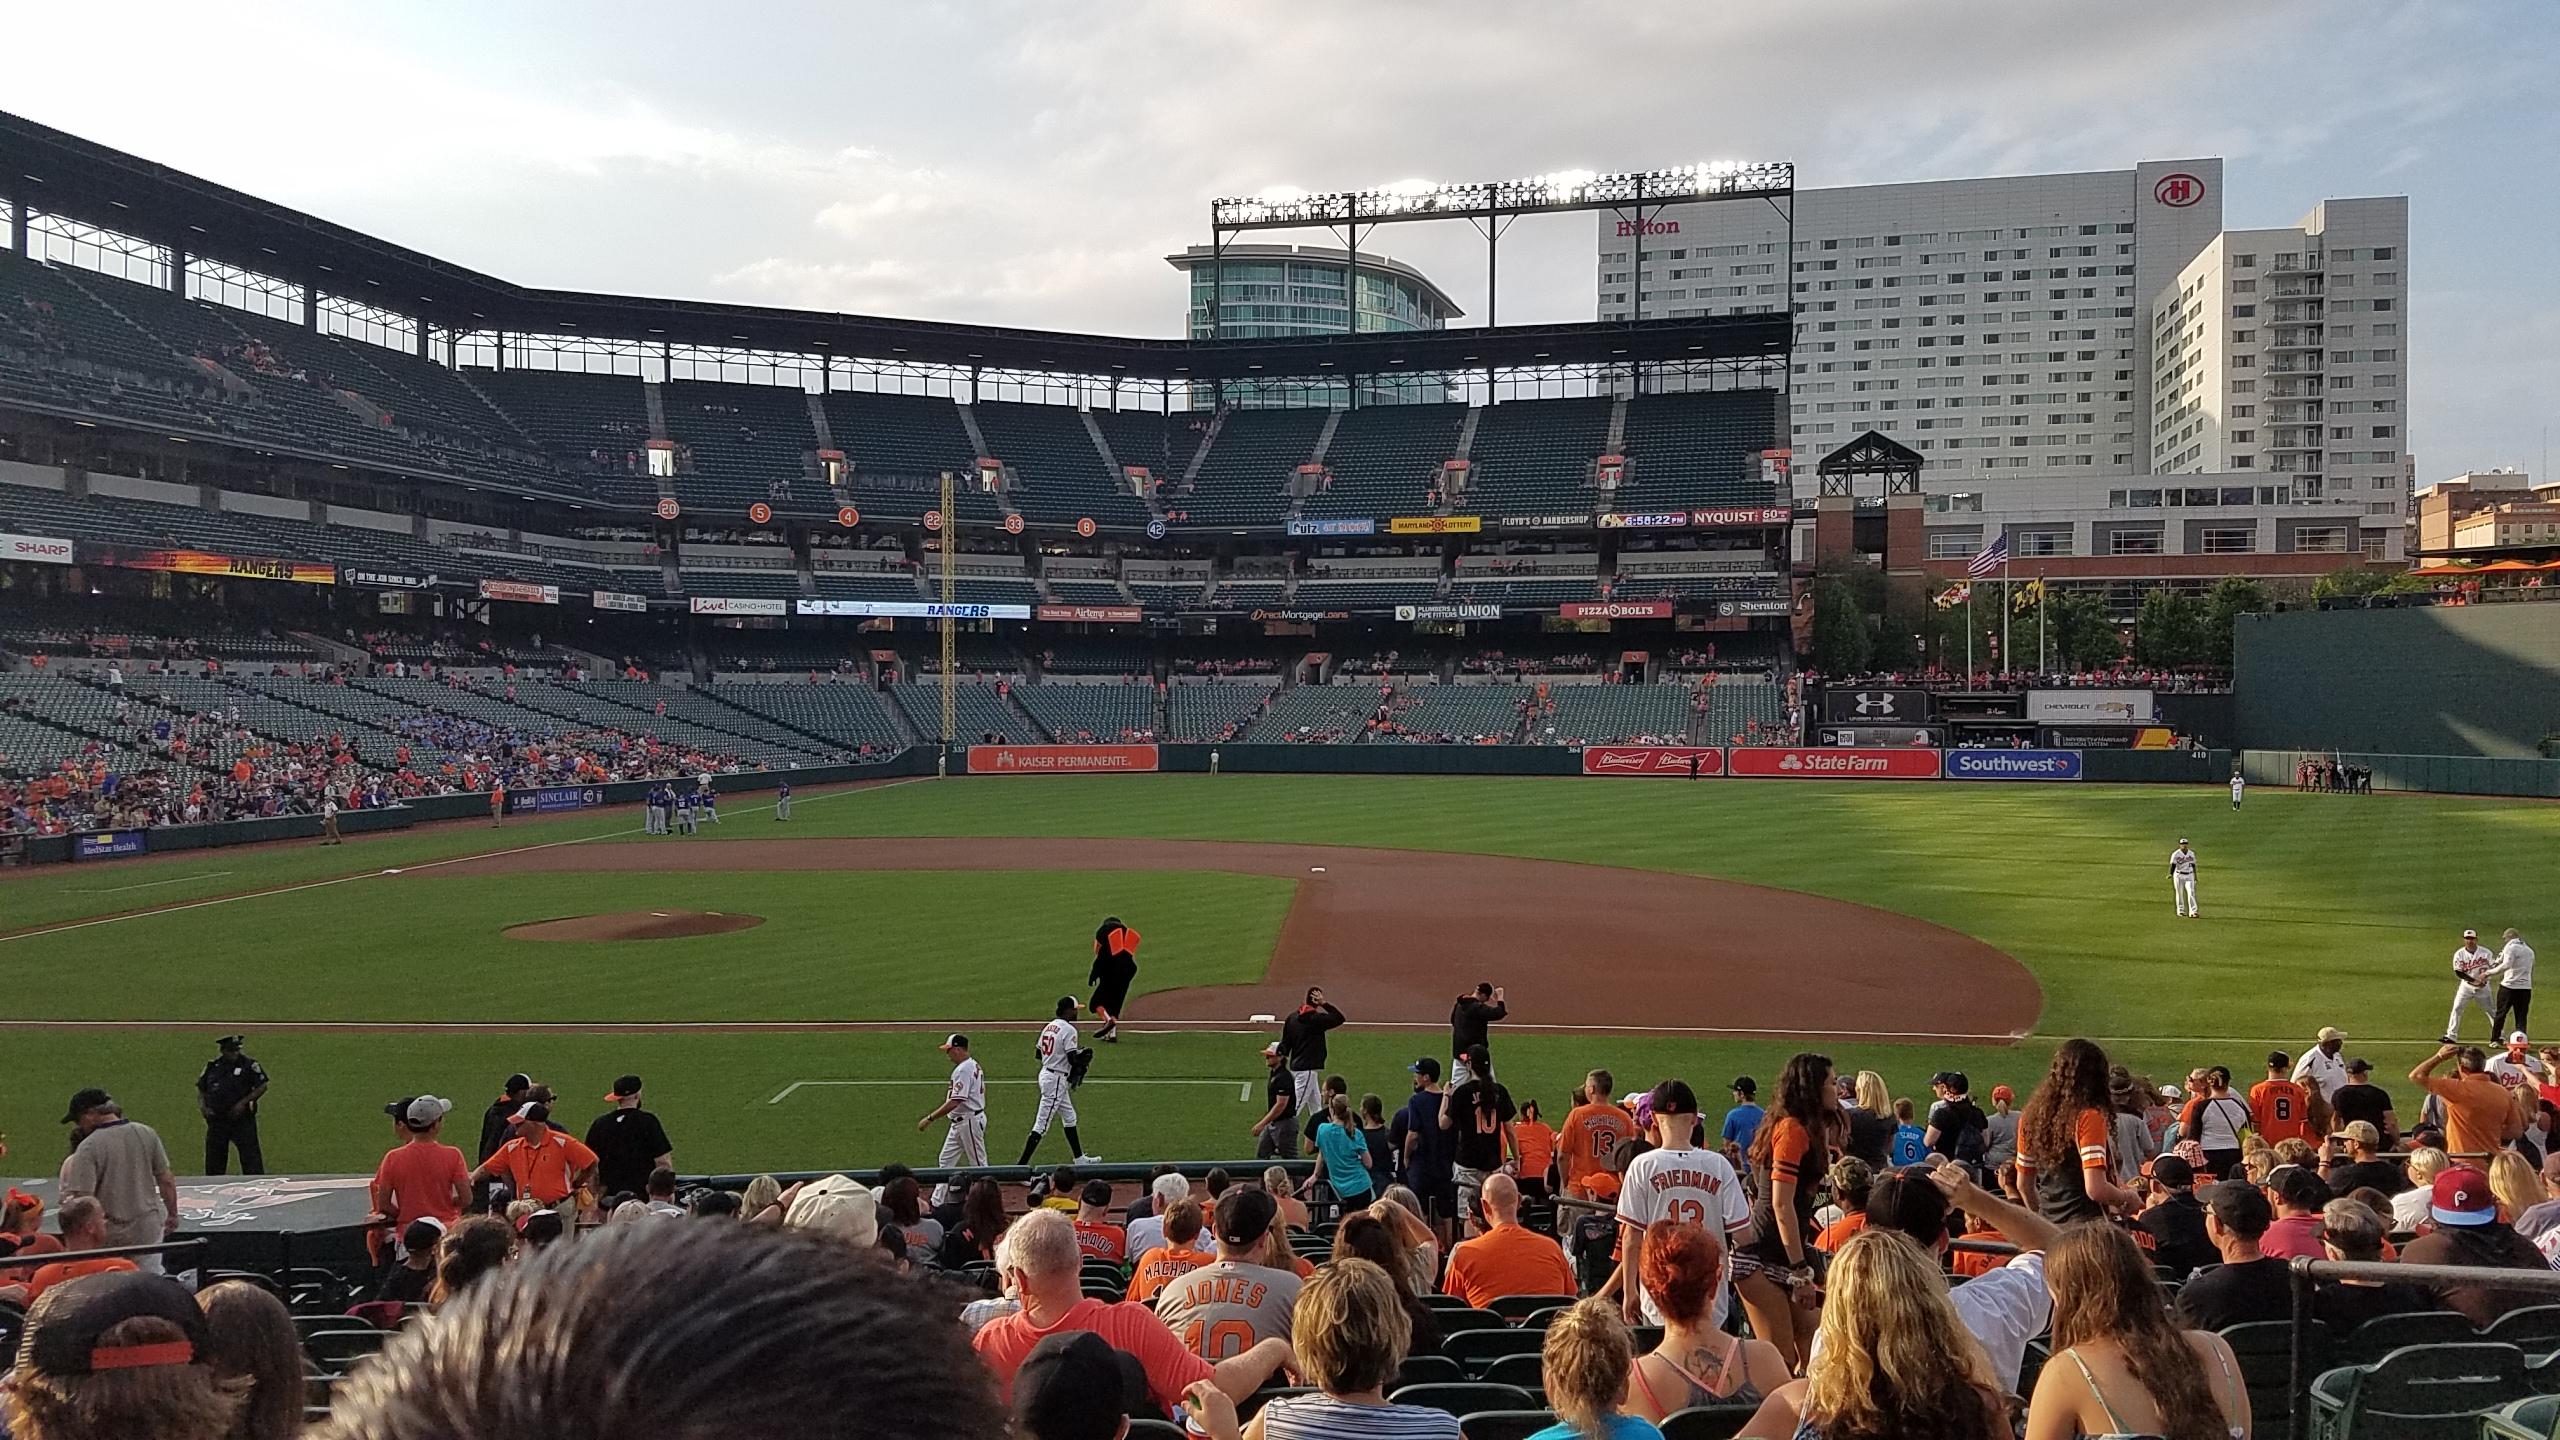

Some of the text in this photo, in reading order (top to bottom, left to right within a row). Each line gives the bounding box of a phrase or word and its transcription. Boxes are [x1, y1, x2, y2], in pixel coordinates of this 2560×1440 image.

[661, 503, 676, 515] 20
[756, 508, 764, 518] 5
[1763, 510, 1777, 519] 60
[844, 511, 852, 522] 4
[926, 515, 940, 526] 22
[1502, 516, 1588, 526] FLOYD'S BARBERSHOP
[1694, 511, 1755, 524] NYQUIST
[1008, 519, 1021, 530] 33
[1083, 522, 1090, 532] 8
[1149, 524, 1163, 535] 42
[1446, 521, 1472, 529] LOTTERY
[15, 542, 69, 555] SHARP
[229, 559, 294, 579] RANGERS
[694, 598, 728, 613] Live!
[927, 605, 990, 616] RANGERS
[1459, 605, 1500, 617] UNION
[1579, 607, 1608, 615] PIZZA
[1740, 601, 1786, 610] Sheraton
[1075, 607, 1105, 619] Airtemp
[1602, 755, 1643, 764] Budweiser
[2191, 751, 2206, 759] 410
[1019, 756, 1128, 767] KAISER PERMANENTE
[1959, 756, 2055, 772] Southwest
[540, 791, 578, 803] SINCLAIR
[83, 842, 137, 855] MedStar Health
[1041, 1035, 1055, 1057] 50
[2275, 1096, 2292, 1122] 8
[1475, 1105, 1497, 1134] 10
[1592, 1130, 1616, 1158] 13
[1903, 1140, 1916, 1161] 6
[1650, 1169, 1722, 1196] FRIEDMAN
[1183, 1278, 1267, 1310] JONES
